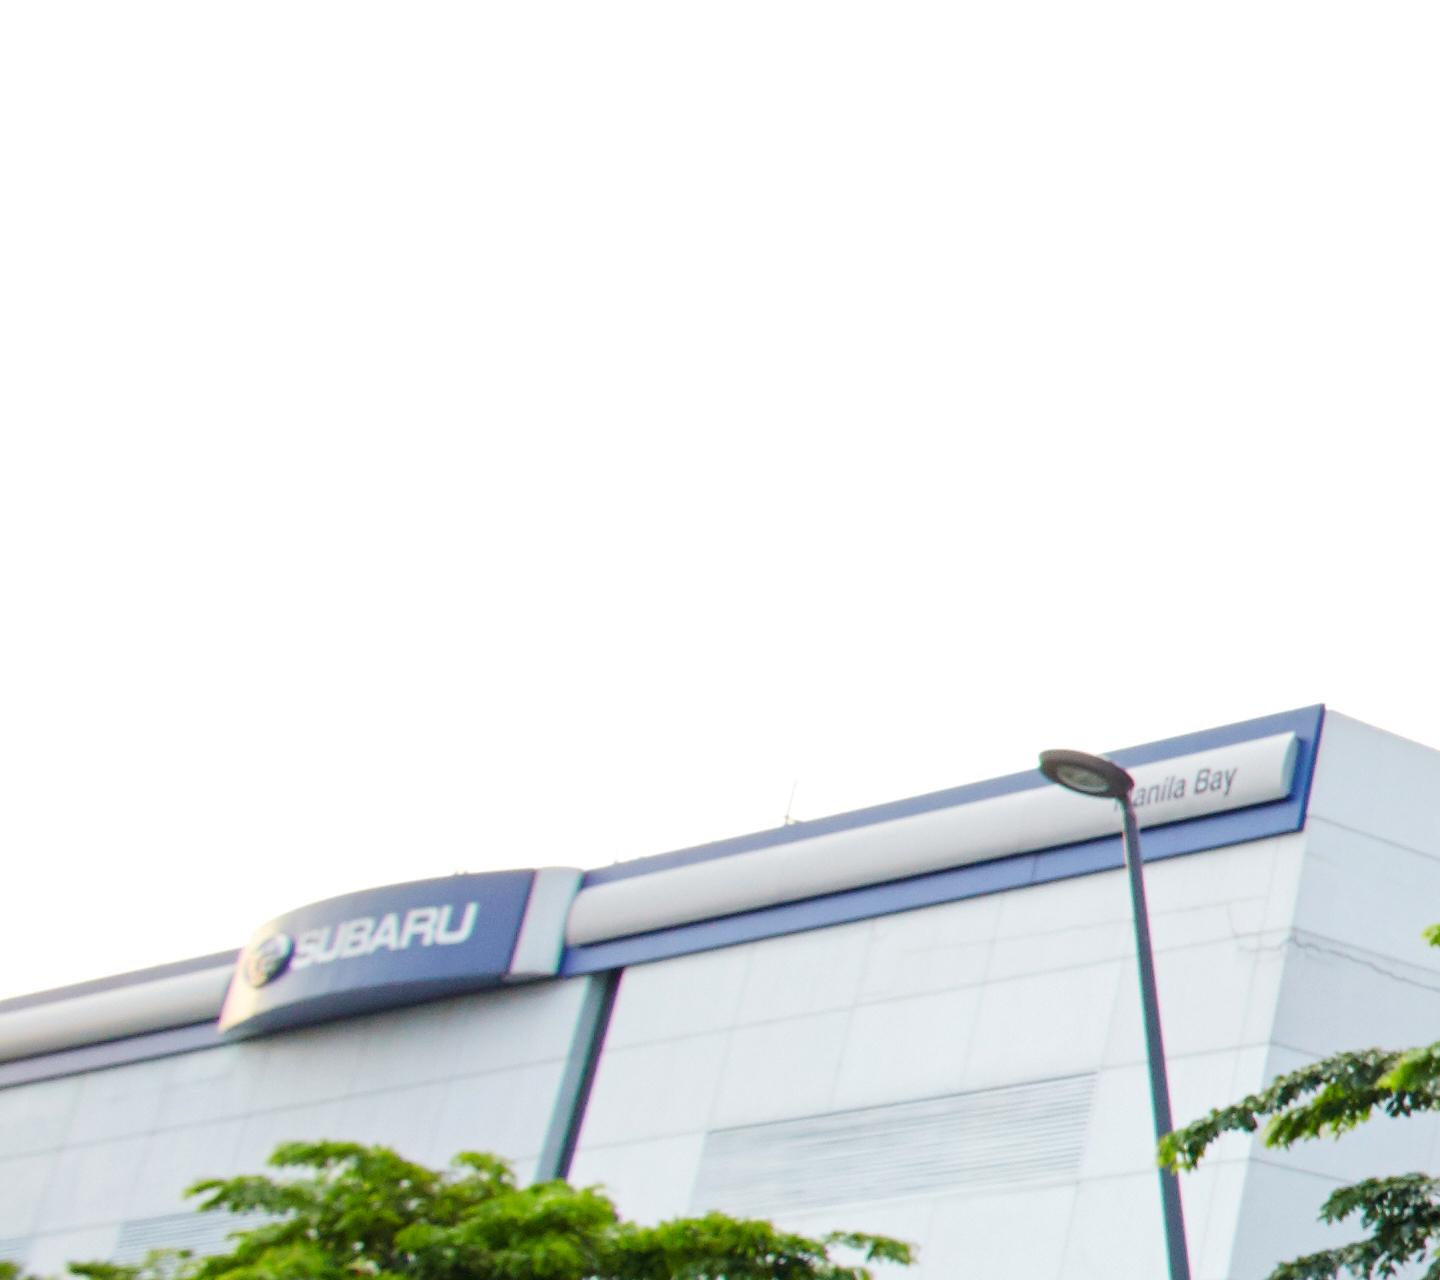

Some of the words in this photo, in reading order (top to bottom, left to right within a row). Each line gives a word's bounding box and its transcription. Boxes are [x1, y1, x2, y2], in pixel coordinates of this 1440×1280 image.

[1113, 774, 1185, 812] anila
[1193, 767, 1238, 798] Bay
[292, 902, 479, 969] SUBARU
